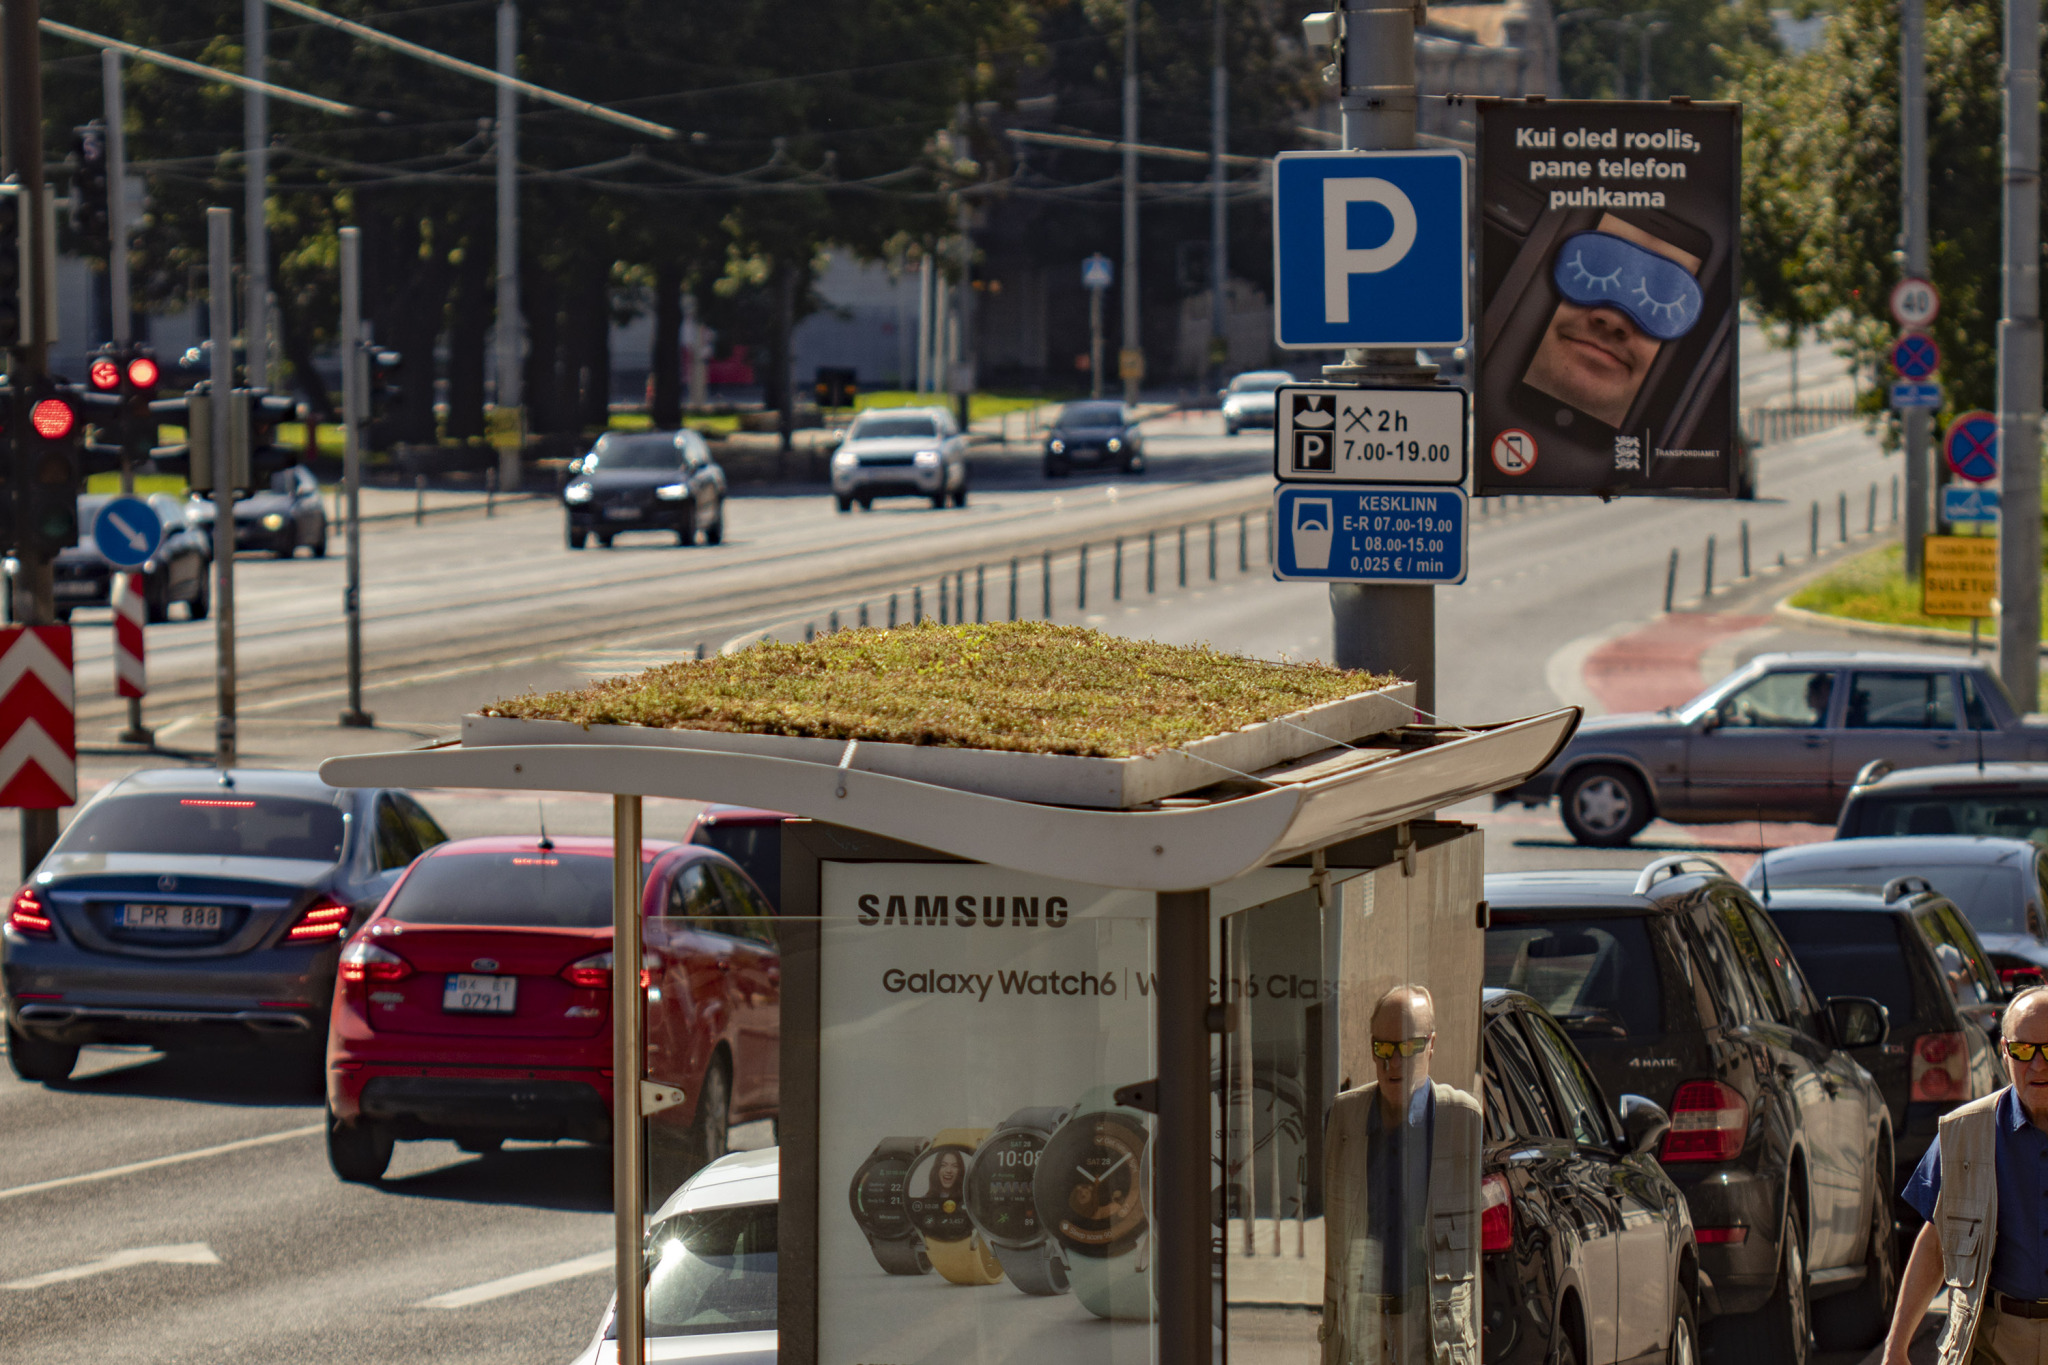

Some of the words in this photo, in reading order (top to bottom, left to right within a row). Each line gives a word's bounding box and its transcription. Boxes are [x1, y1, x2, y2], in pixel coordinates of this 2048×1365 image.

[1516, 127, 1556, 147] Kui
[1562, 127, 1618, 148] oled
[1624, 128, 1700, 153] roolis,
[1529, 160, 1592, 180] pane
[1598, 157, 1686, 178] telefon
[1550, 186, 1666, 210] puhkama
[1322, 176, 1418, 324] P
[1902, 290, 1929, 313] 40
[1302, 435, 1325, 468] P
[1343, 440, 1450, 462] 7.00-19.00
[1359, 496, 1437, 512] KESKLINN
[1343, 516, 1369, 531] E-R
[1374, 516, 1453, 532] 07.00-19.00
[1352, 537, 1360, 551] L
[1365, 537, 1444, 553] 08.00-15.00
[1350, 556, 1390, 573] 0,025
[1393, 557, 1403, 571] €
[1416, 558, 1444, 572] min
[126, 906, 168, 924] LPR
[857, 894, 1069, 928] SAMSUNG
[882, 968, 994, 1003] Galaxy
[998, 969, 1117, 996] Watch6
[461, 993, 502, 1008] 0791
